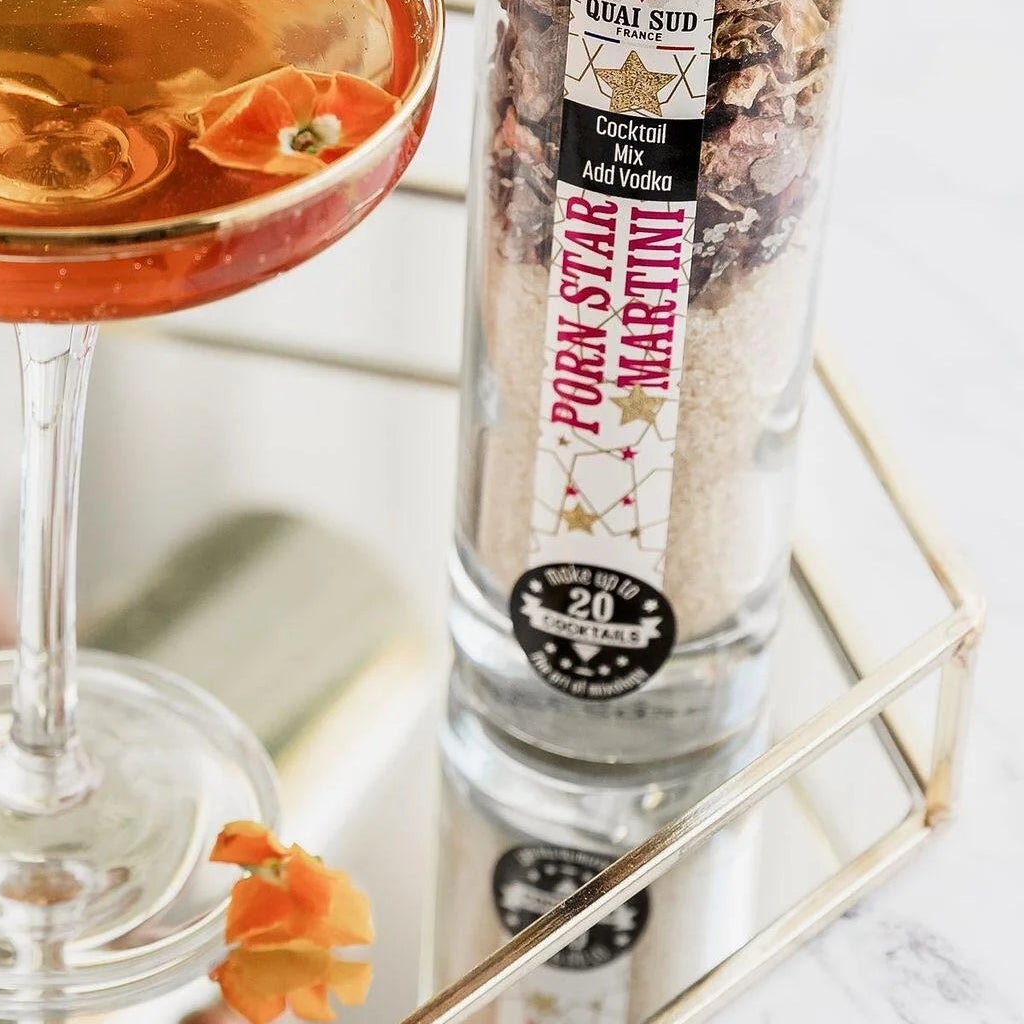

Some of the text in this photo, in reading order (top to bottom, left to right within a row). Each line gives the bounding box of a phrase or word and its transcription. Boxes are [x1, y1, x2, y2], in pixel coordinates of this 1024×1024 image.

[616, 27, 663, 42] FRANCE
[649, 10, 698, 32] SUD
[596, 115, 667, 144] Cocktail
[614, 143, 644, 166] Mix
[582, 160, 673, 192] Add Vodka
[617, 207, 685, 390] MARTINI
[551, 196, 619, 435] PORN STAR
[594, 570, 620, 592] up
[617, 580, 640, 600] to
[567, 587, 615, 623] 20
[543, 615, 640, 641] COCKTAILS
